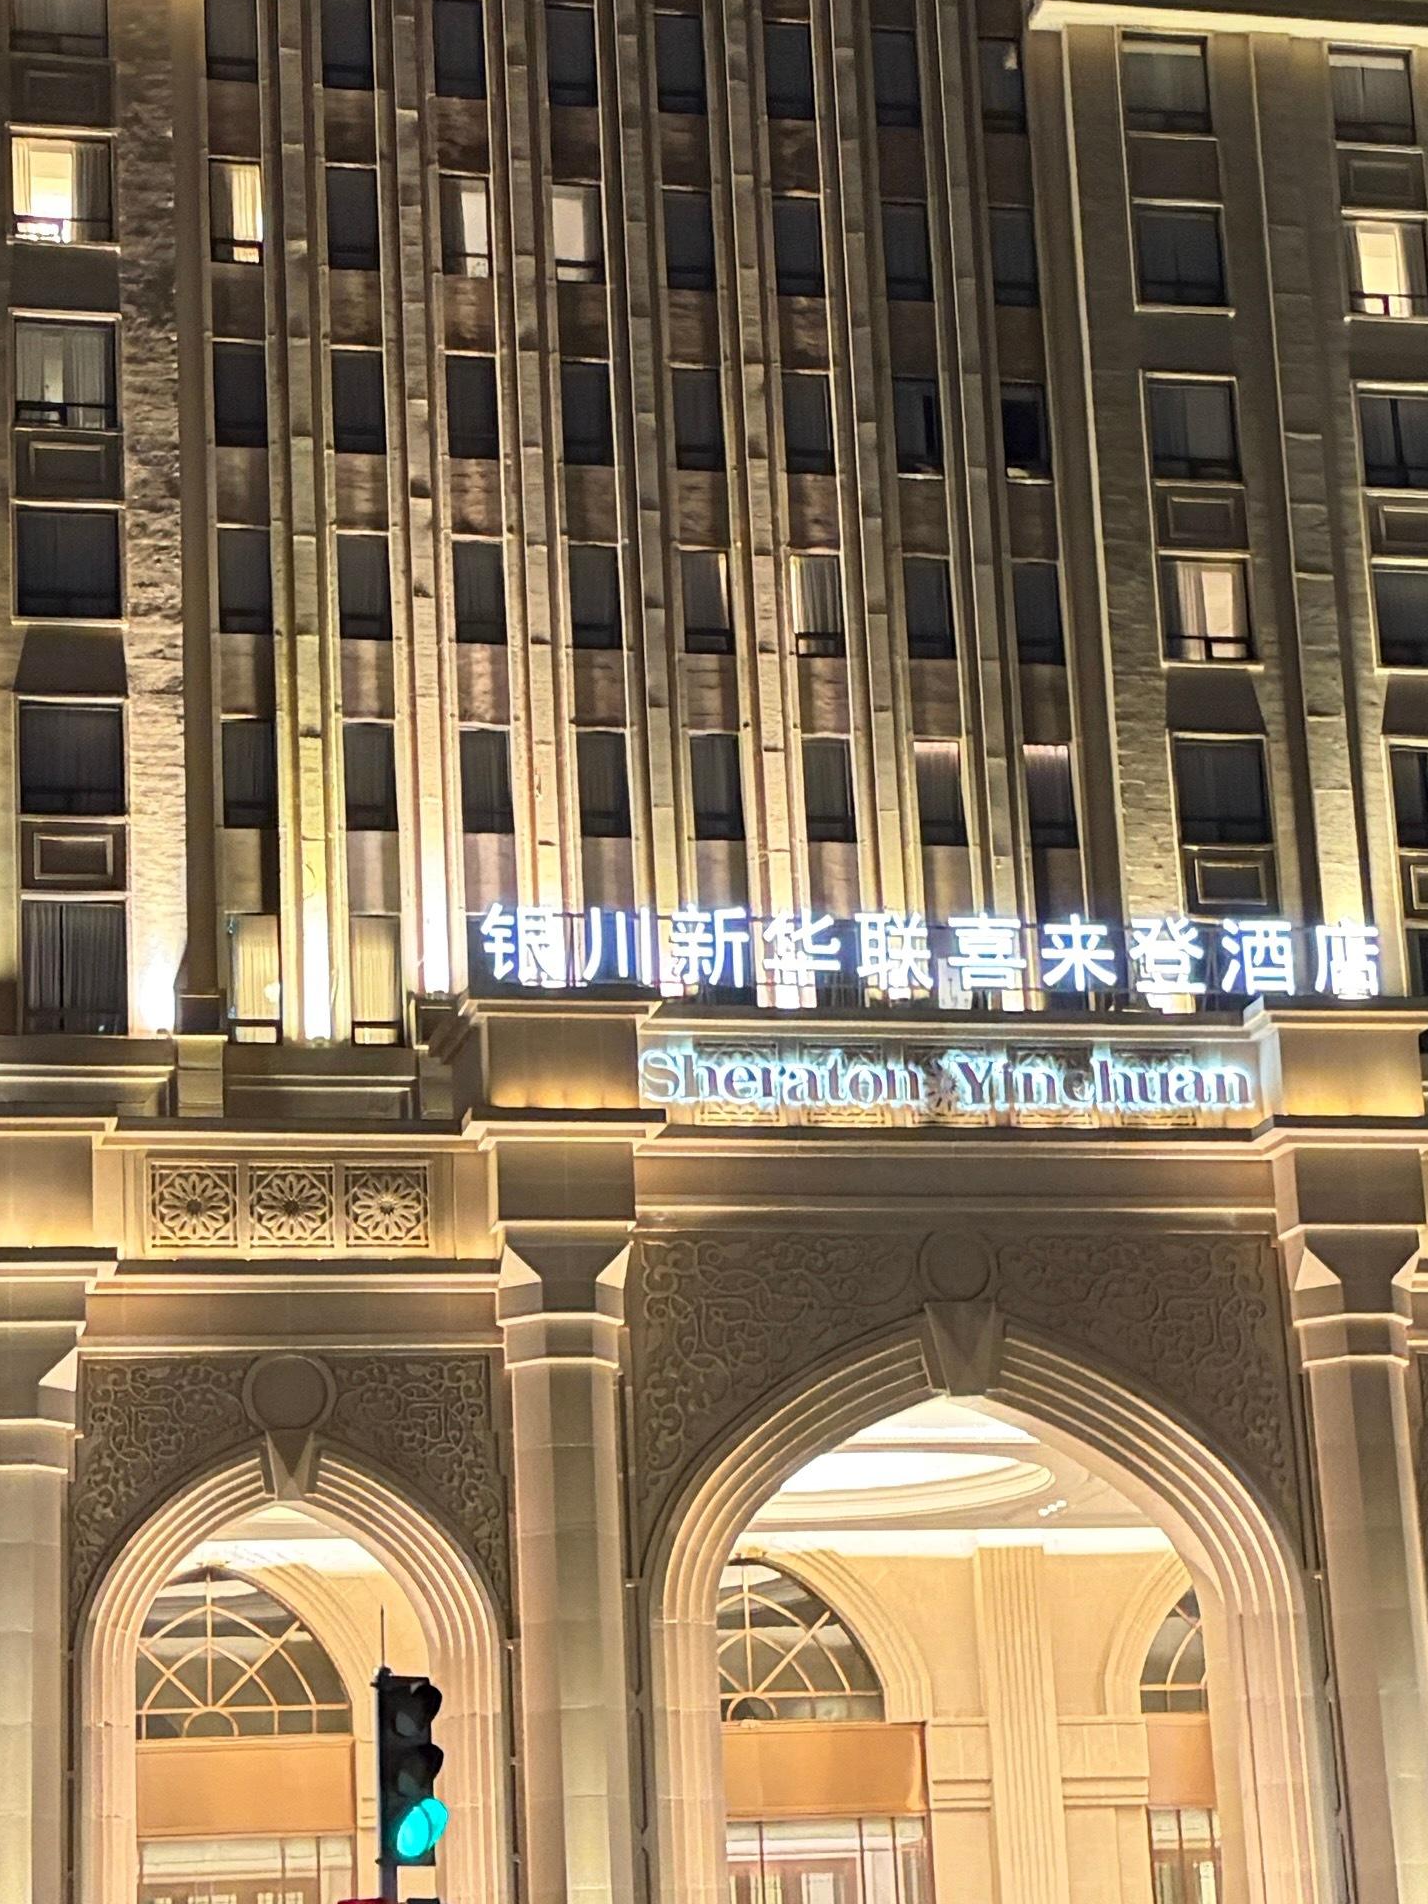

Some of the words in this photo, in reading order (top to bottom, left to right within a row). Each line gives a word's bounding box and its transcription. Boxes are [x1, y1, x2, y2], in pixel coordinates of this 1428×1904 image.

[480, 899, 1381, 1000] 银川新华联喜来登酒店
[638, 1047, 926, 1108] Sheraton
[942, 1046, 1255, 1111] Yinchuan
